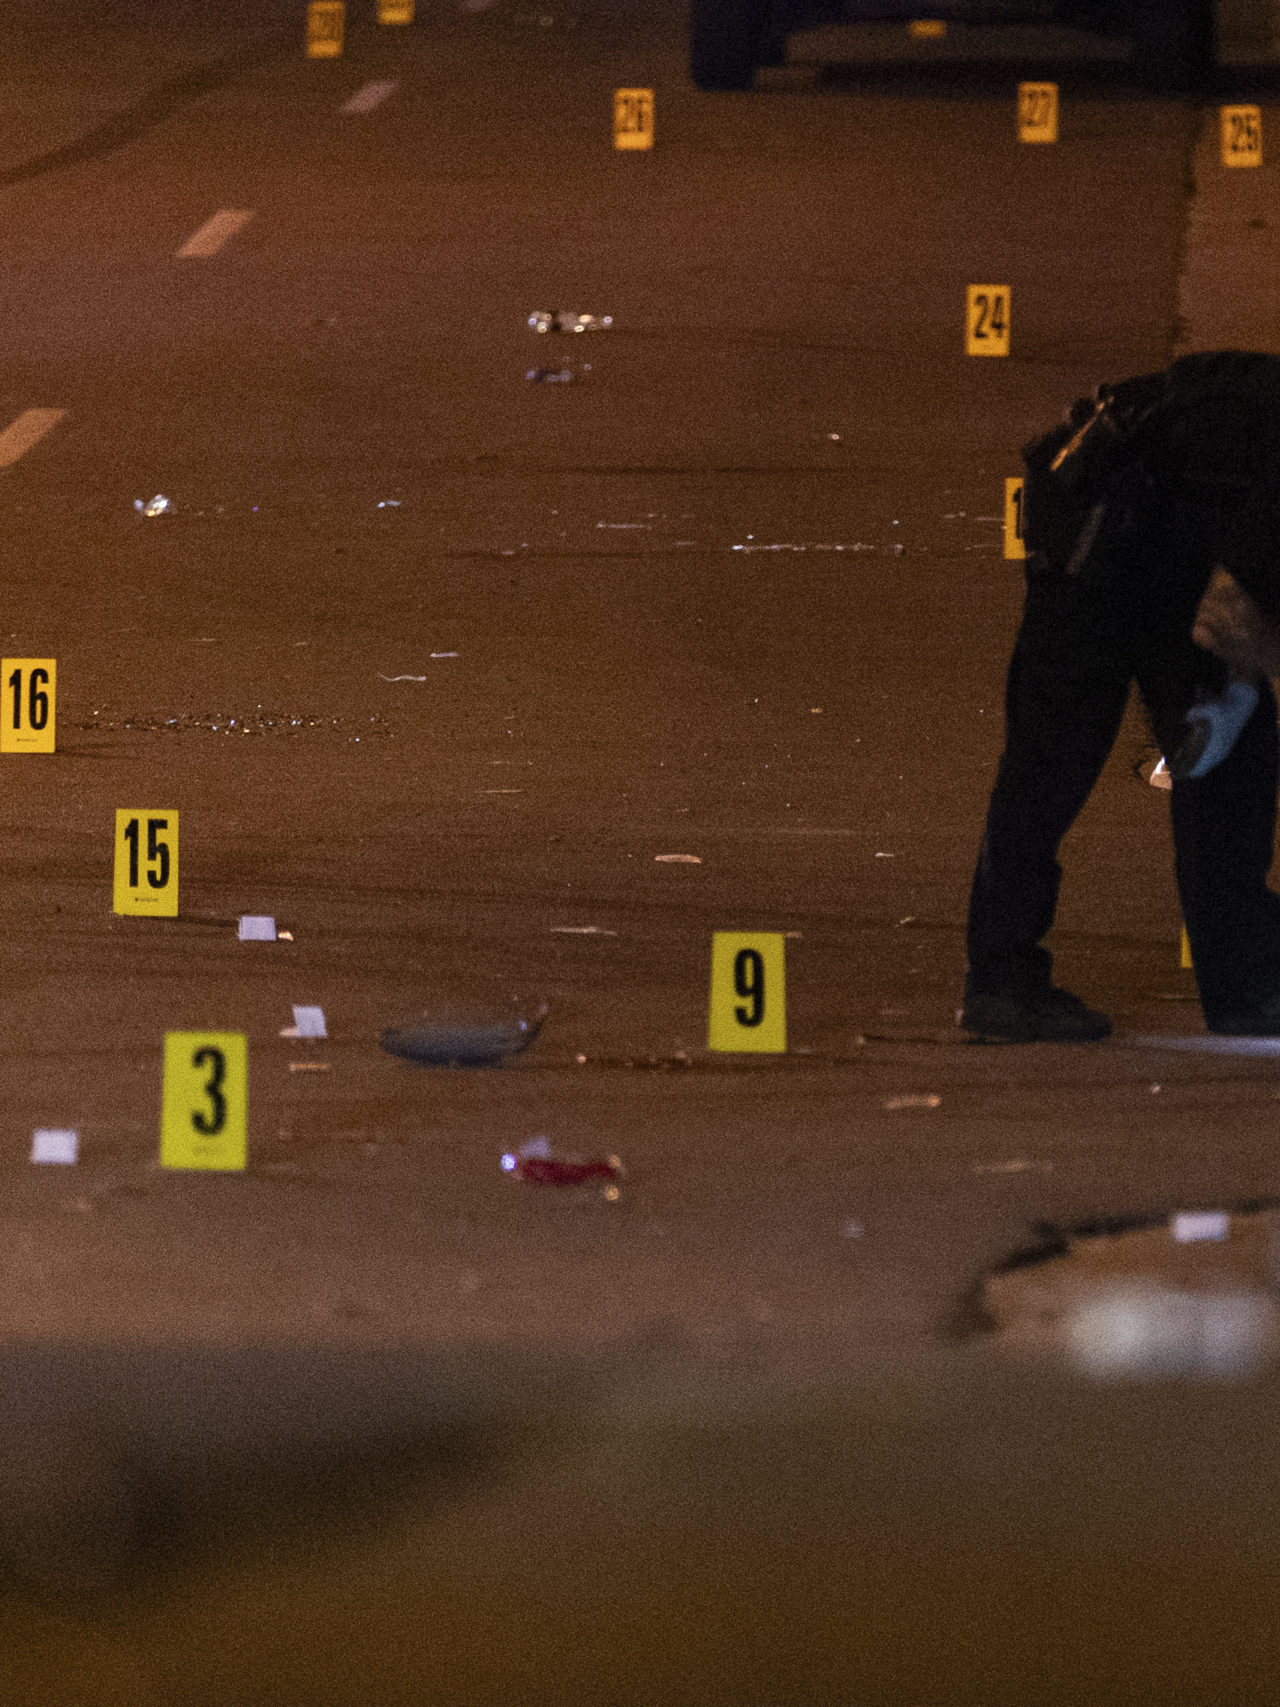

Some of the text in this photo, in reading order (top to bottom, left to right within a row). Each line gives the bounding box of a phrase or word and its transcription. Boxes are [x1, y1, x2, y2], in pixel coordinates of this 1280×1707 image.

[1230, 114, 1260, 152] 25
[974, 293, 1005, 338] 24
[9, 667, 49, 731] 16
[124, 818, 170, 889] 15
[734, 948, 765, 1028] 9
[192, 1046, 227, 1136] 3
